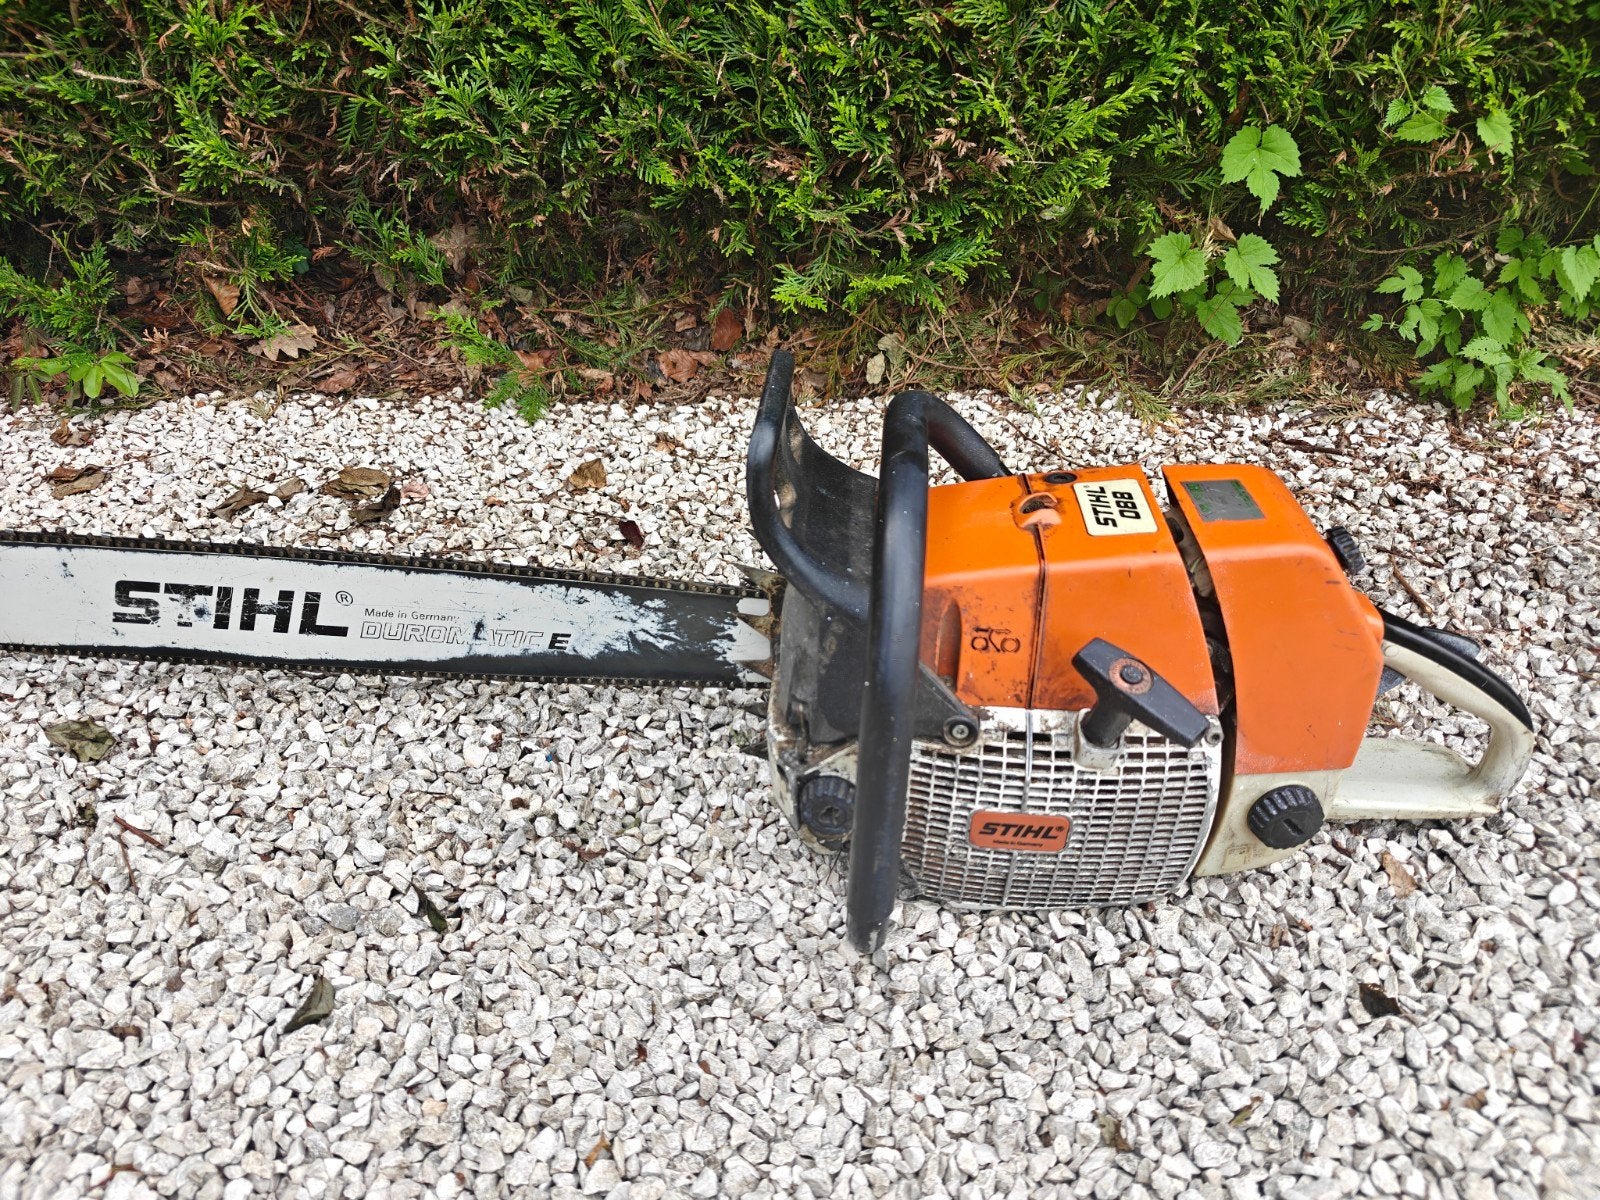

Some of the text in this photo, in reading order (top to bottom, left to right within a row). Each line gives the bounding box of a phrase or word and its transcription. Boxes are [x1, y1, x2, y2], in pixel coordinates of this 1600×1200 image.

[1085, 485, 1118, 528] STIHL
[1111, 491, 1141, 520] 088
[112, 579, 349, 638] STIHL
[364, 608, 394, 618] Made
[397, 610, 407, 619] in
[548, 632, 572, 650] E
[979, 822, 1059, 839] STIHL
